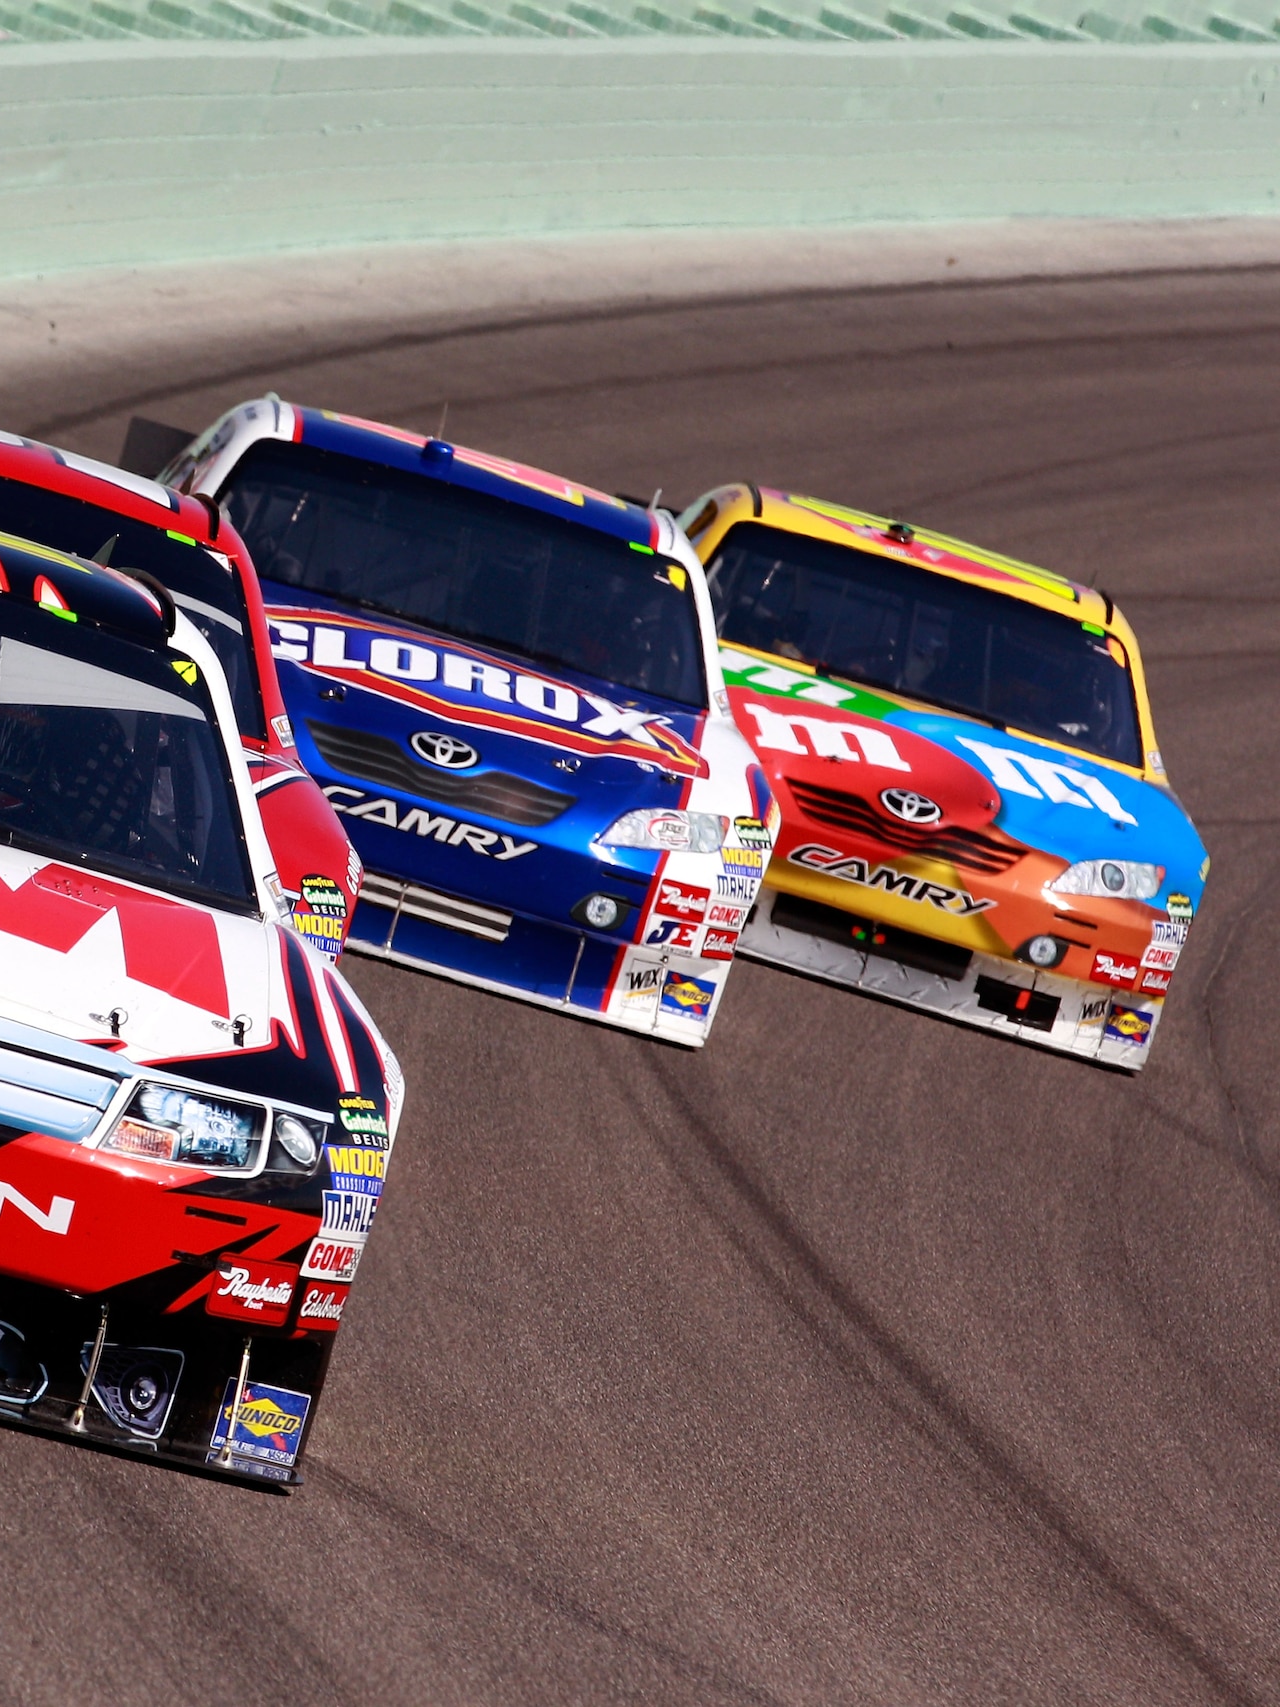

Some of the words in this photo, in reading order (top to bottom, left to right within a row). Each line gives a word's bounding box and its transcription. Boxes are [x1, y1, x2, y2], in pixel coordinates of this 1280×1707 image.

[267, 618, 675, 748] CLOROX
[744, 703, 912, 773] m
[955, 736, 1139, 827] m
[321, 785, 538, 860] CAMRY
[721, 847, 762, 869] MOOG
[717, 875, 755, 900] MAHLE
[787, 843, 998, 917] CAMRY
[312, 904, 347, 917] BELTS
[708, 905, 740, 922] COMP
[293, 913, 344, 940] MOOG
[646, 921, 698, 947] JE
[1155, 923, 1186, 946] MAHLE
[1146, 949, 1173, 965] COMP
[630, 967, 661, 990] WIX
[1082, 1000, 1108, 1019] WIX
[352, 1133, 389, 1149] BELTS
[327, 1146, 384, 1178] MOOG
[335, 1176, 365, 1192] CHASSIS
[323, 1192, 377, 1233] MAHLE
[308, 1242, 355, 1271] COMP
[217, 1267, 293, 1307] Raybestos
